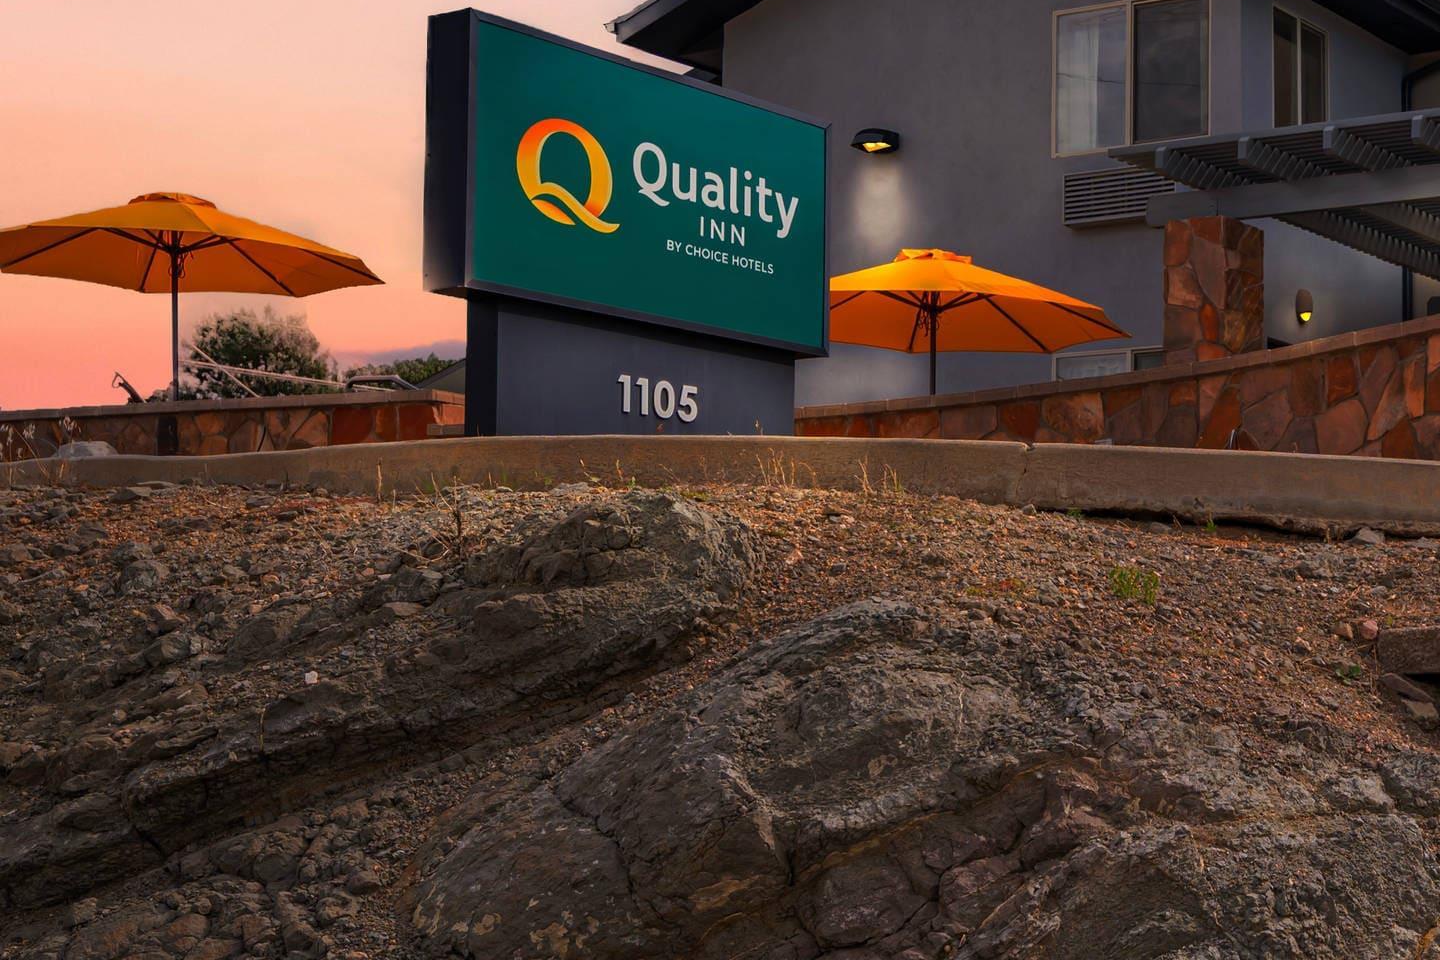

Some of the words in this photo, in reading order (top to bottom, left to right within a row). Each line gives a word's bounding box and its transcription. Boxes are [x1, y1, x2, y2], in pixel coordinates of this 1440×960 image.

[516, 118, 620, 233] Q
[632, 141, 799, 238] Quality
[699, 215, 745, 247] INN
[666, 240, 682, 252] BY
[685, 244, 729, 264] CHOICE
[731, 255, 774, 275] HOTELS
[617, 374, 699, 423] 1105
